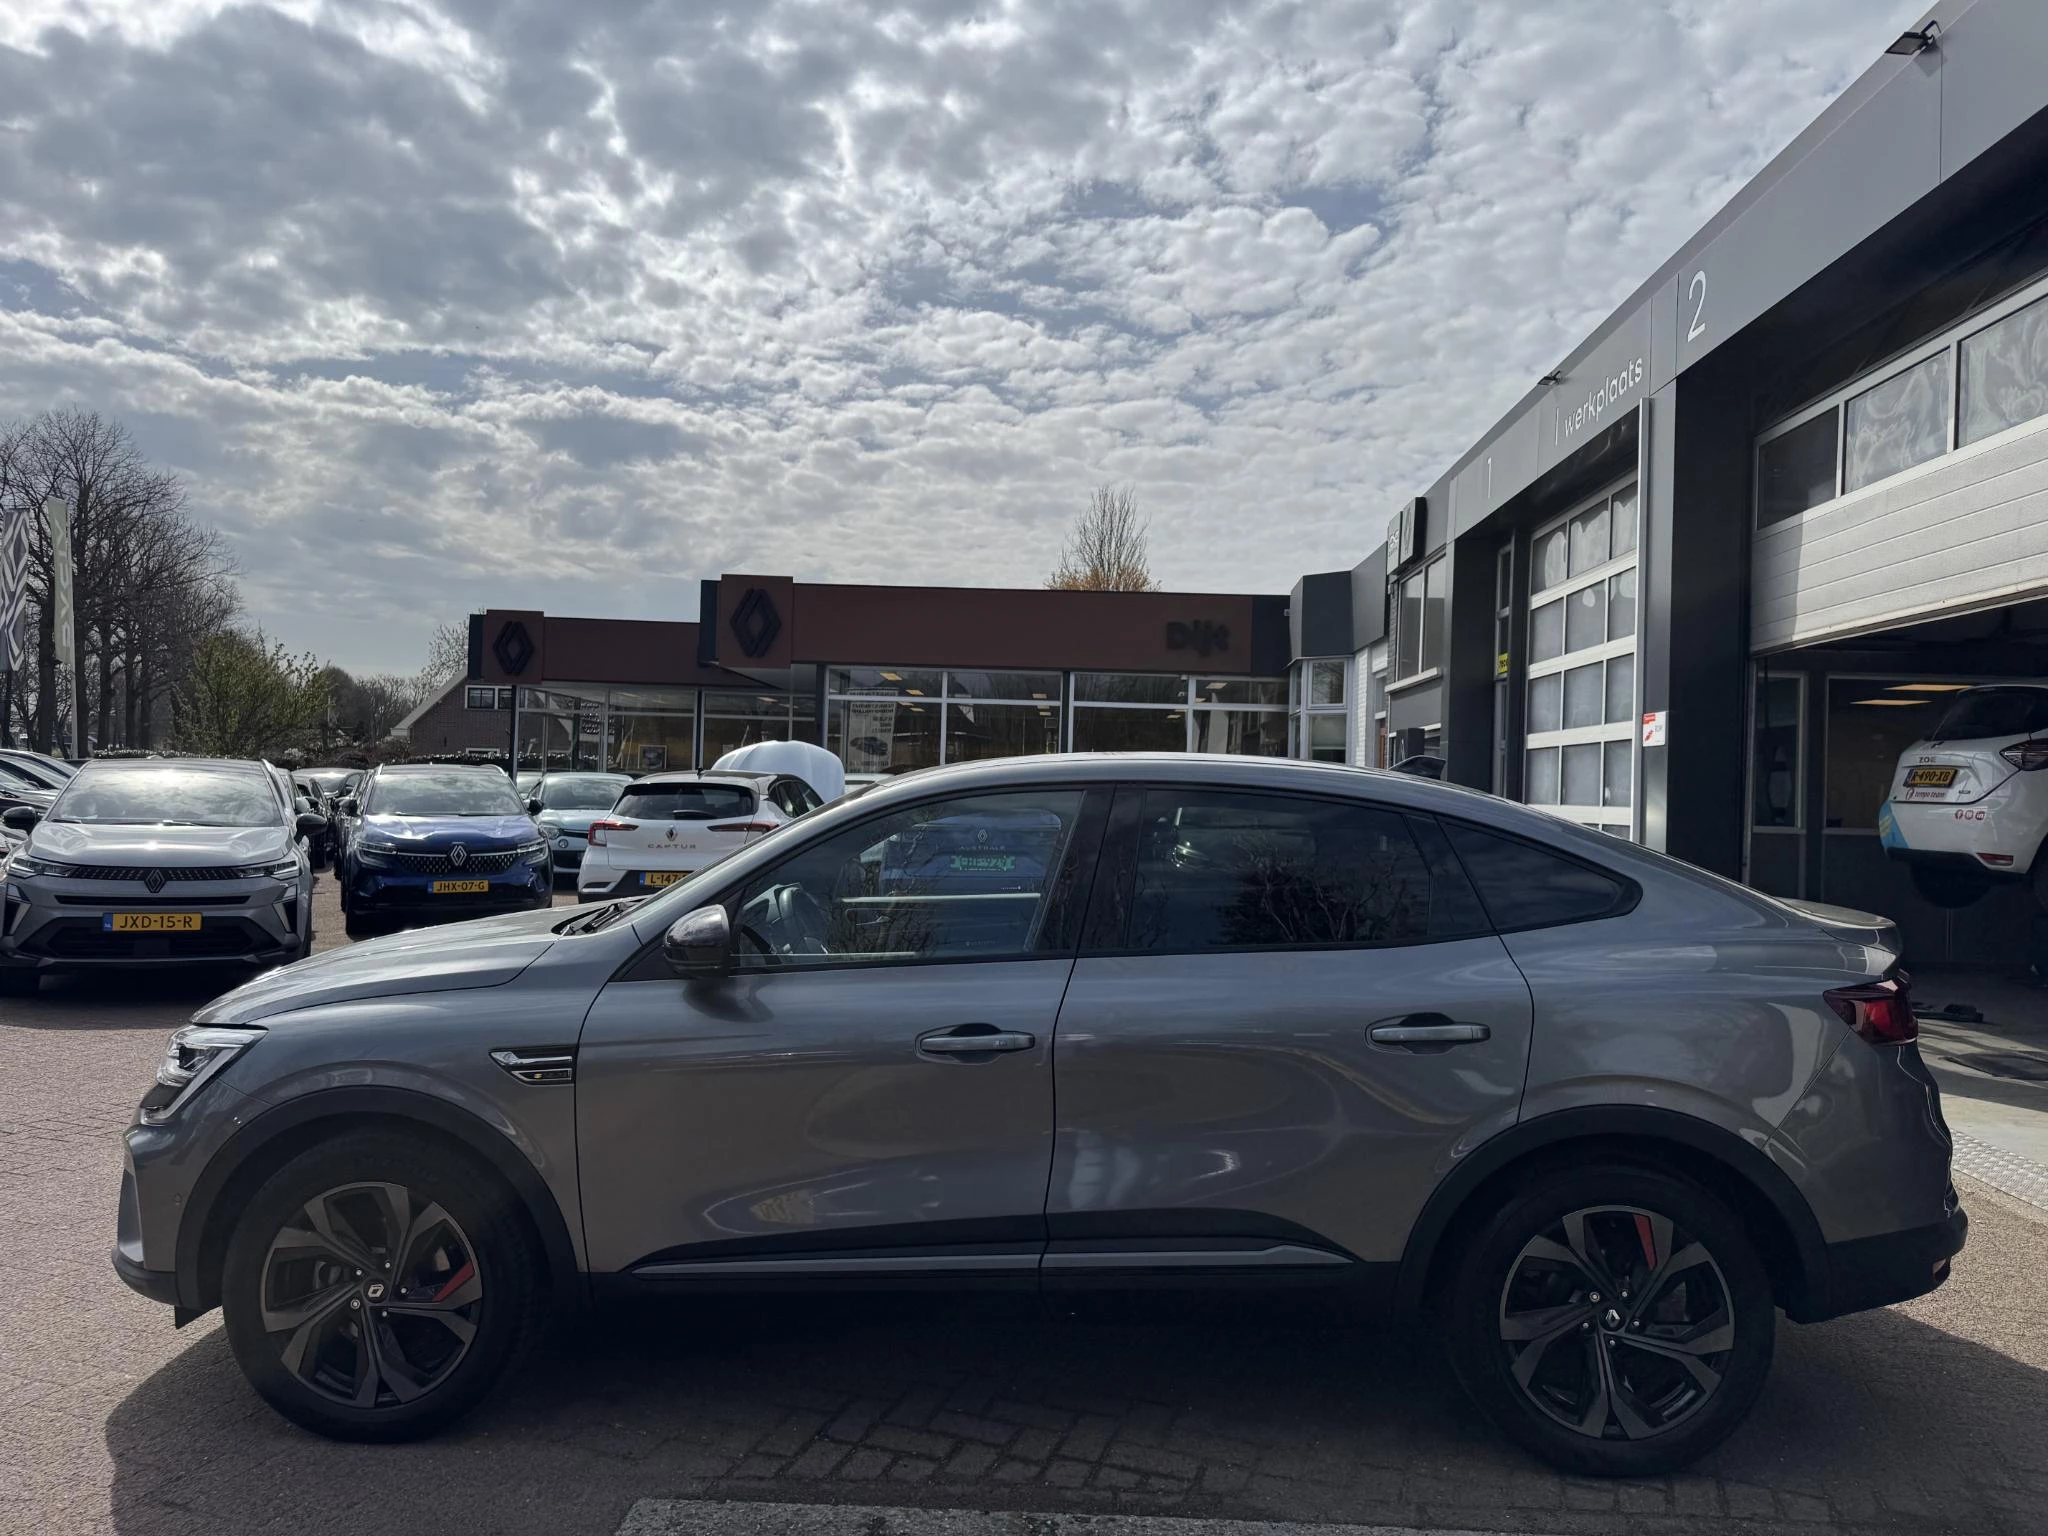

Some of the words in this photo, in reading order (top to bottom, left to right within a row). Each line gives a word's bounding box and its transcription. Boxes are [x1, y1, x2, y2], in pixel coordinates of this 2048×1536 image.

[1688, 270, 1706, 342] 2
[1564, 357, 1642, 437] werkplaats
[436, 881, 485, 892] JHX-07-G
[120, 915, 192, 929] JXD-15-R
